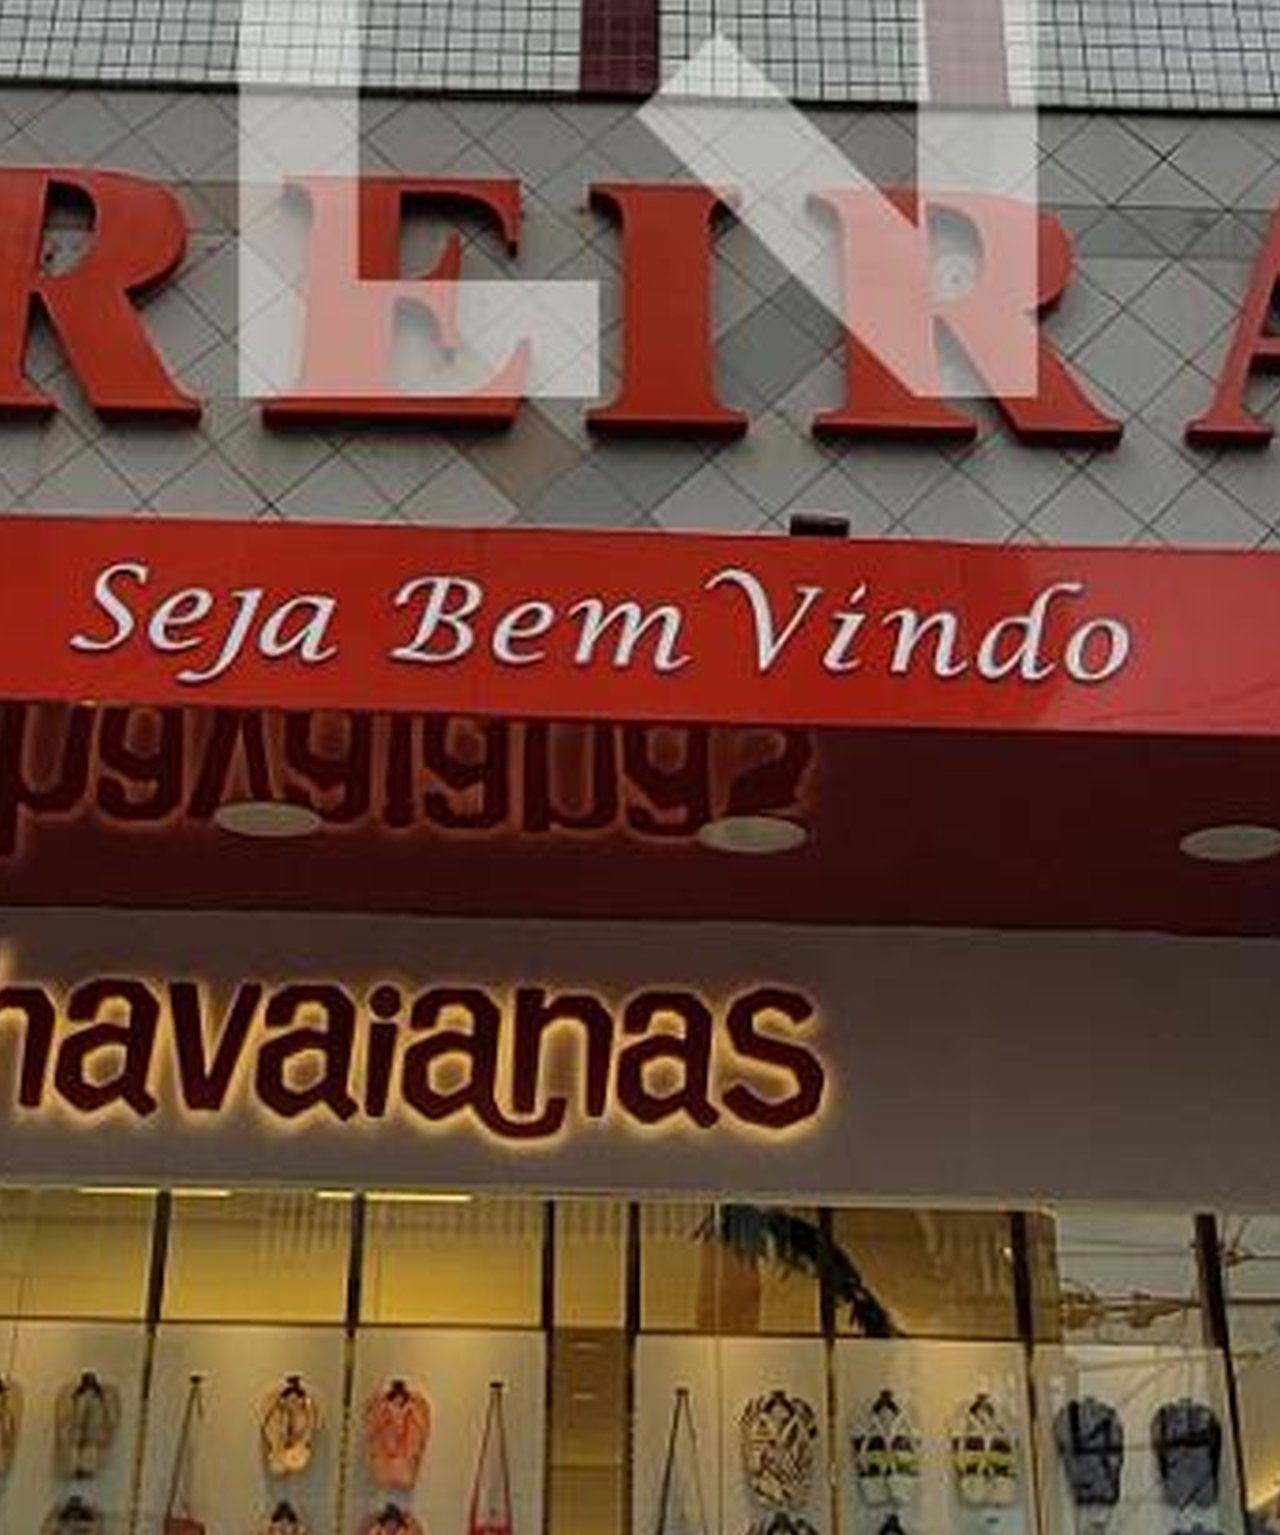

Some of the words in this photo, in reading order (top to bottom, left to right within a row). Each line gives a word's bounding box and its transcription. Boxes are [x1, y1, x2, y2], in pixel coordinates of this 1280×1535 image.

[70, 560, 338, 684] Seja
[390, 574, 693, 672] Bem
[703, 566, 1133, 684] Vindo
